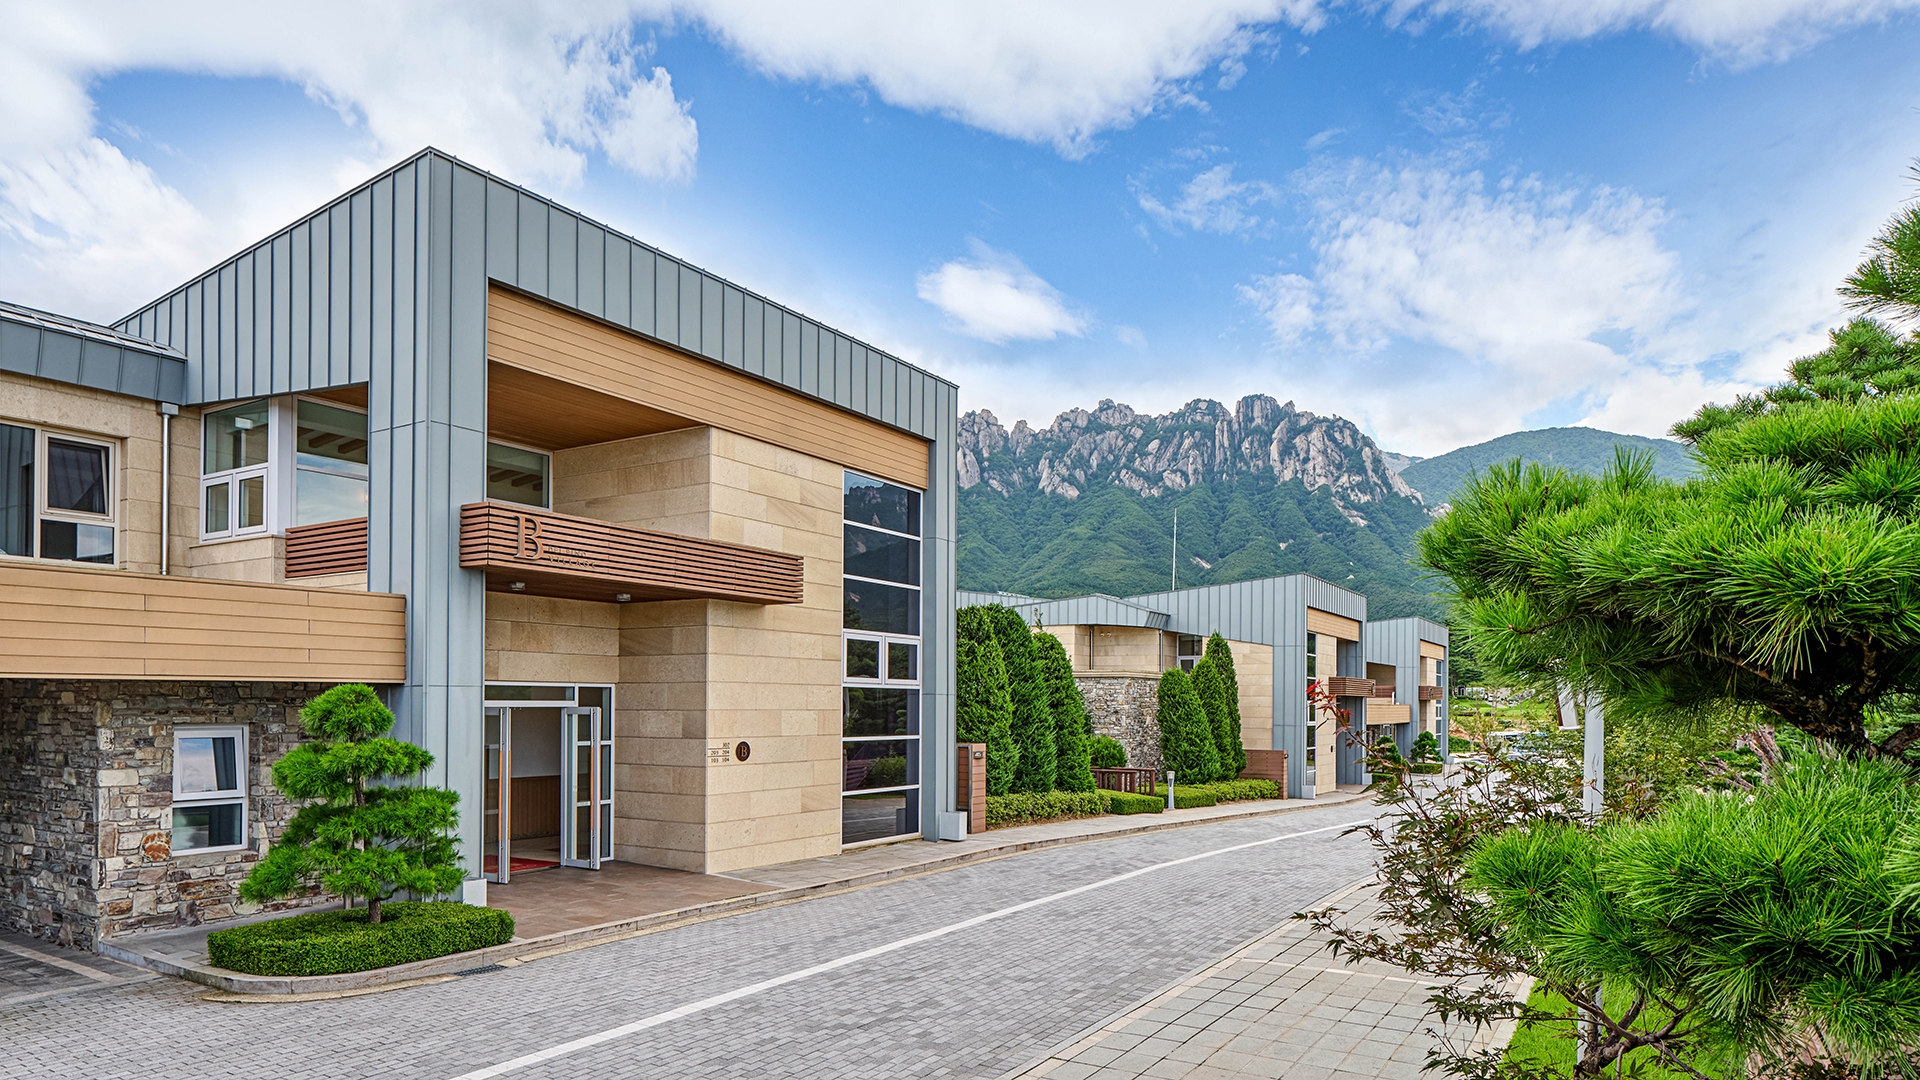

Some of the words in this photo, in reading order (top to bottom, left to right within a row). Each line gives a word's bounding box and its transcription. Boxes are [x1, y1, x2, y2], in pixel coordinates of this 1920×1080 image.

[513, 515, 545, 560] B
[548, 555, 596, 570] VILLAGE
[741, 745, 748, 757] B
